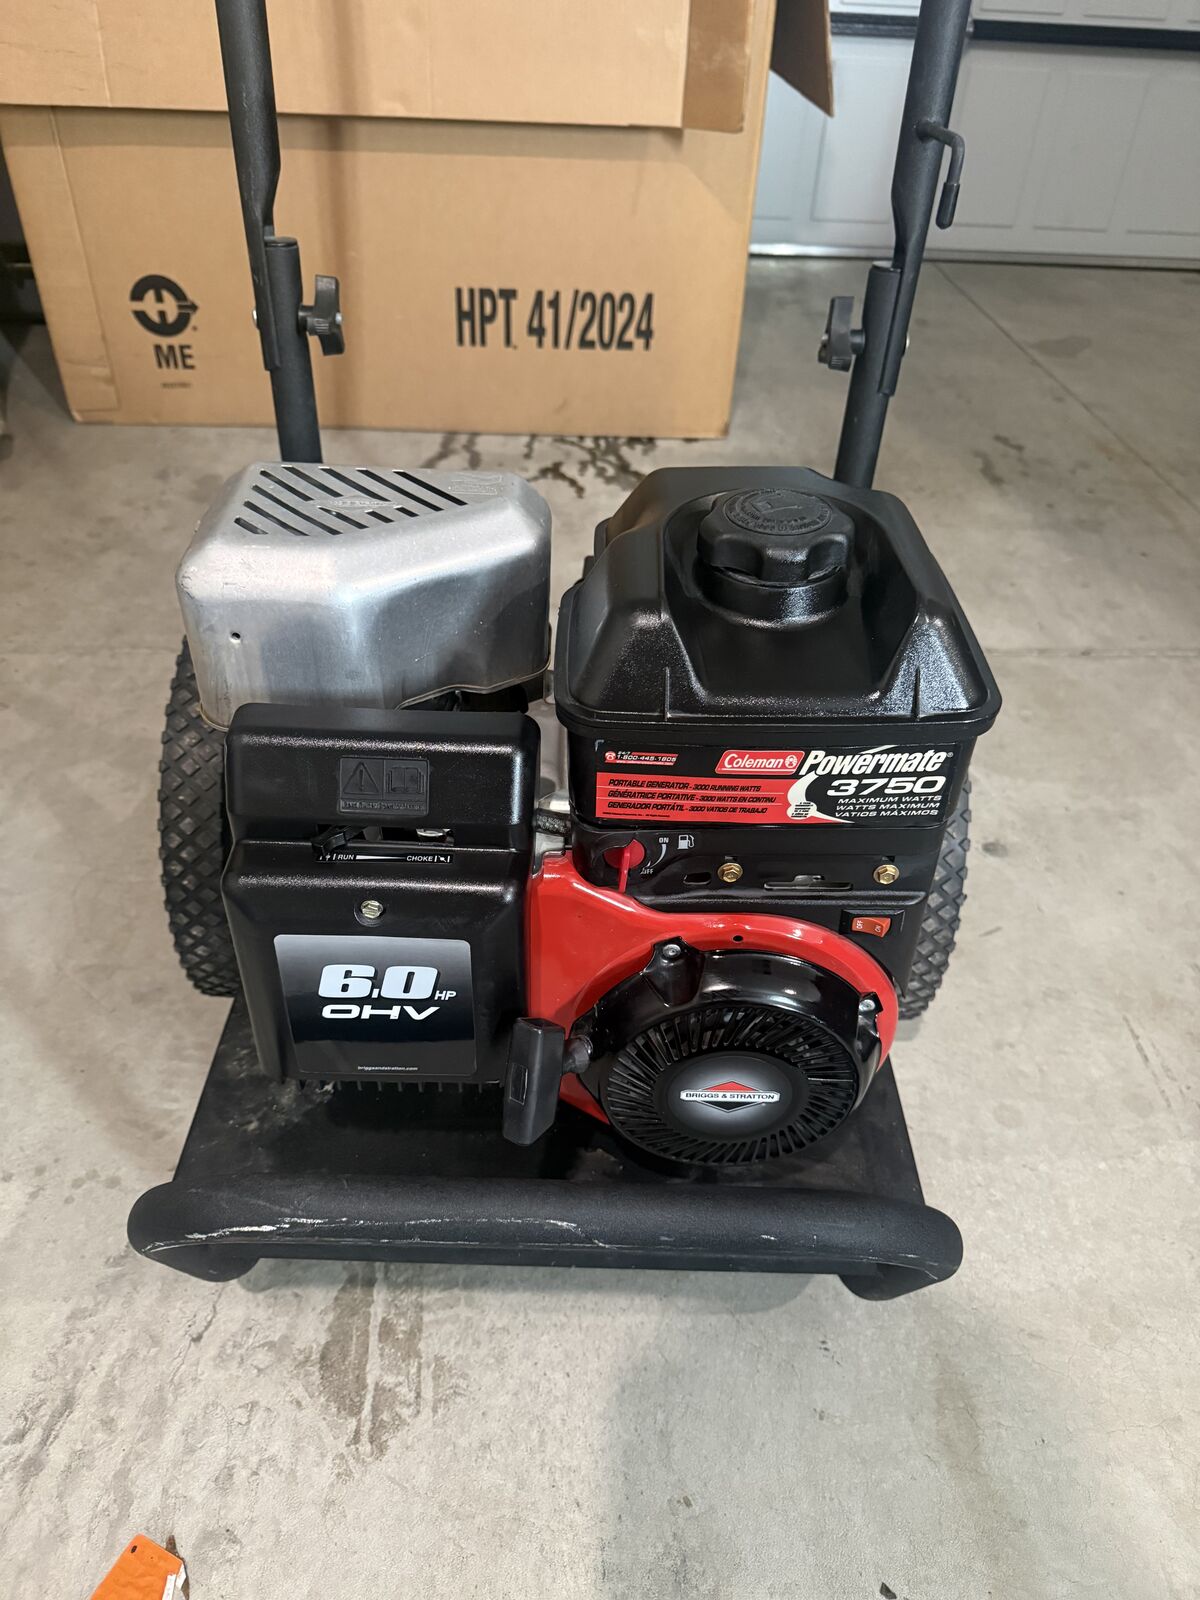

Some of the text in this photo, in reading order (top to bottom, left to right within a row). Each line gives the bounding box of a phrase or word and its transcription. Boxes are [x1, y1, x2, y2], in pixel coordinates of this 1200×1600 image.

[526, 289, 654, 351] 41/2024
[153, 344, 196, 370] ME
[724, 753, 784, 769] Coleman
[799, 748, 947, 775] Powermate
[608, 779, 646, 788] PORTABLE
[646, 781, 689, 790] GENERATOR
[693, 783, 710, 791] 3000
[827, 775, 946, 796] 3750
[607, 789, 656, 799] GÉNÉRATRICE
[656, 792, 696, 801] PORTATIVE
[837, 796, 899, 804] MAXIMUM
[607, 801, 651, 810] GENERADOR
[651, 802, 684, 812] PORTÁTIL
[878, 802, 940, 810] MAXIMUM
[317, 964, 457, 1001] 6.0 HP
[321, 1004, 441, 1021] OHV
